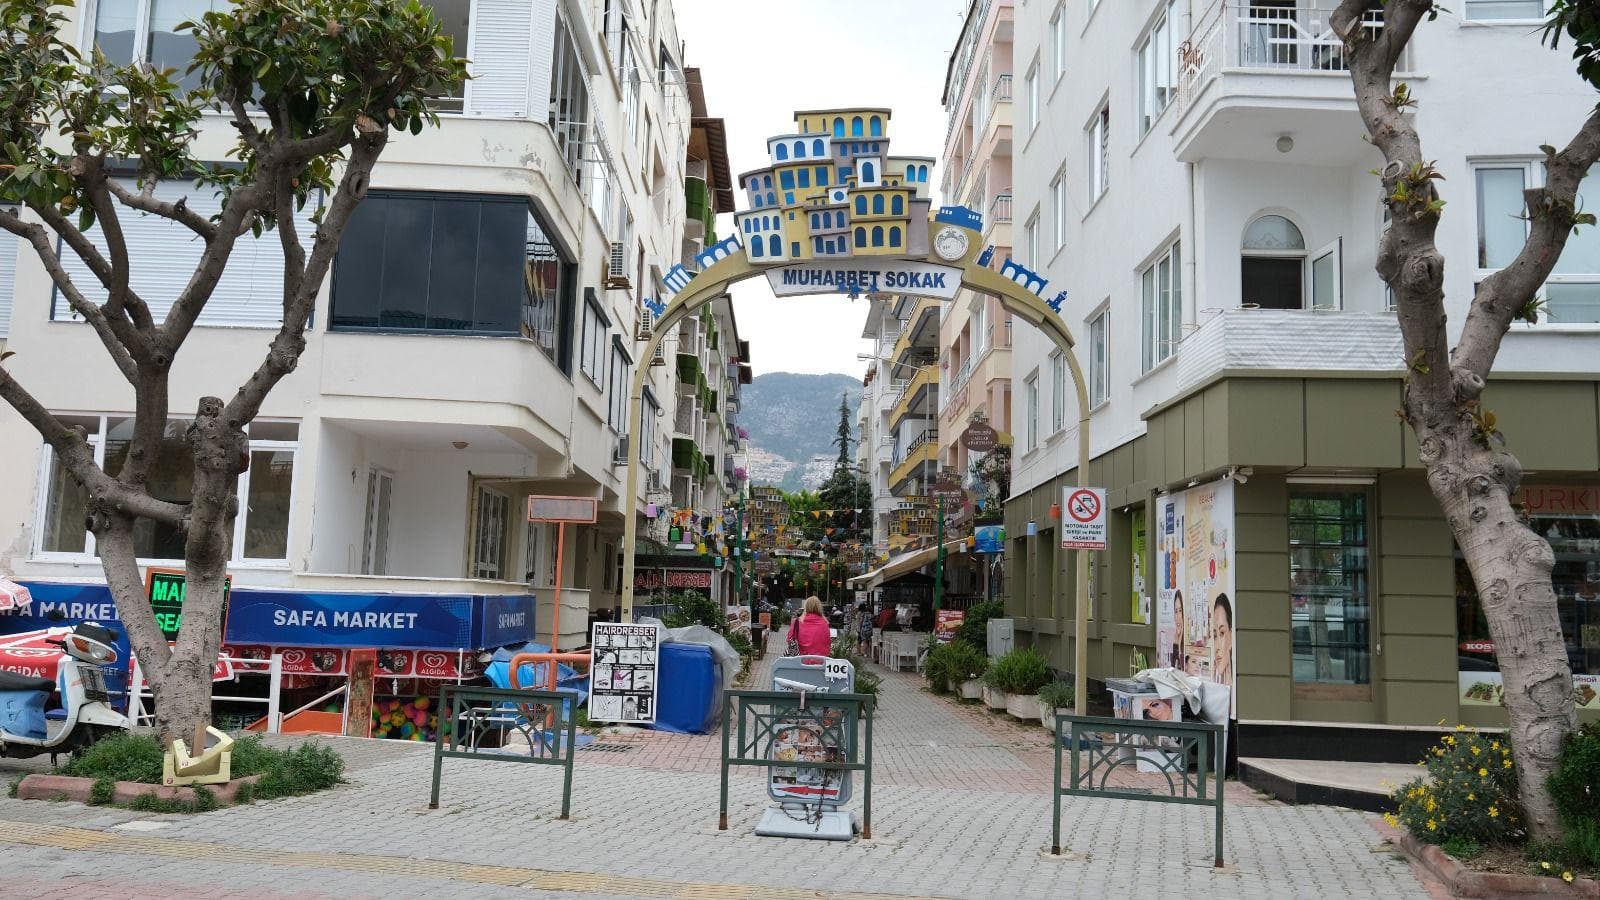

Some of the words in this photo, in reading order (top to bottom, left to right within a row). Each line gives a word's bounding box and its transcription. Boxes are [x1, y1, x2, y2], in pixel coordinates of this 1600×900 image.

[783, 269, 880, 289] MUHABBET
[885, 271, 946, 289] SOKAK
[666, 571, 712, 588] DRESSER
[273, 608, 326, 628] SAFA
[333, 610, 418, 630] MARKET
[596, 625, 656, 636] HAIRDRESSER
[826, 664, 848, 674] 10€
